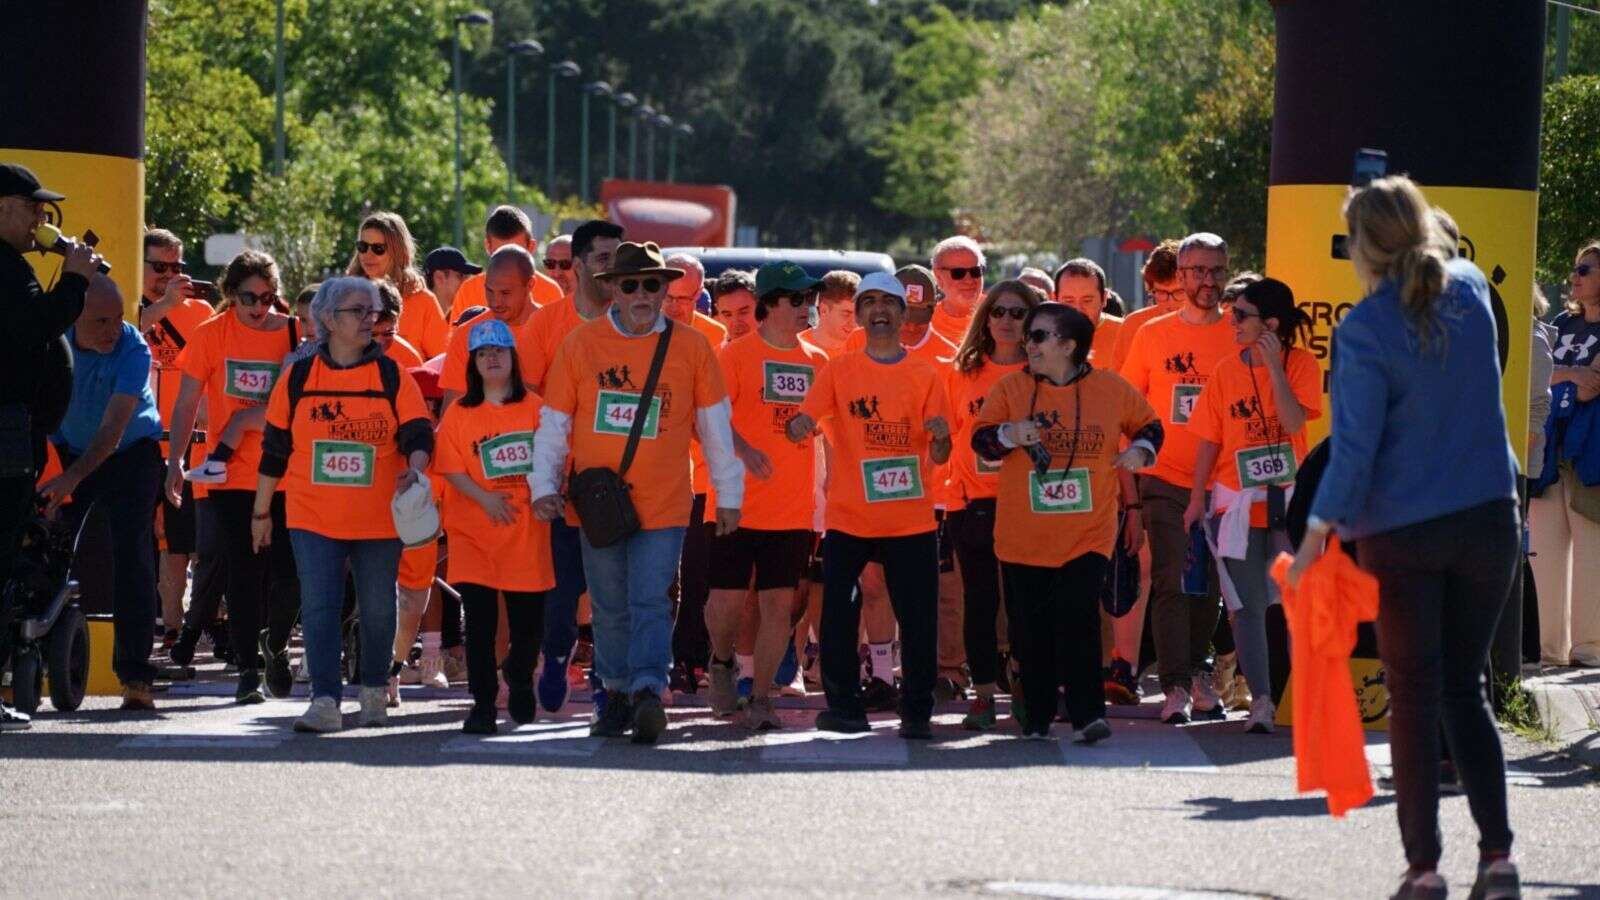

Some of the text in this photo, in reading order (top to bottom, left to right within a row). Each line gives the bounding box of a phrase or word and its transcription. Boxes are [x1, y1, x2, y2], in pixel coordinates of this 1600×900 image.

[239, 371, 268, 389] 431
[776, 375, 806, 393] 383
[611, 406, 637, 423] 44
[1050, 431, 1105, 442] CARERA
[495, 445, 529, 462] 483
[326, 455, 361, 473] 465
[1251, 458, 1284, 477] 369
[878, 471, 909, 488] 474
